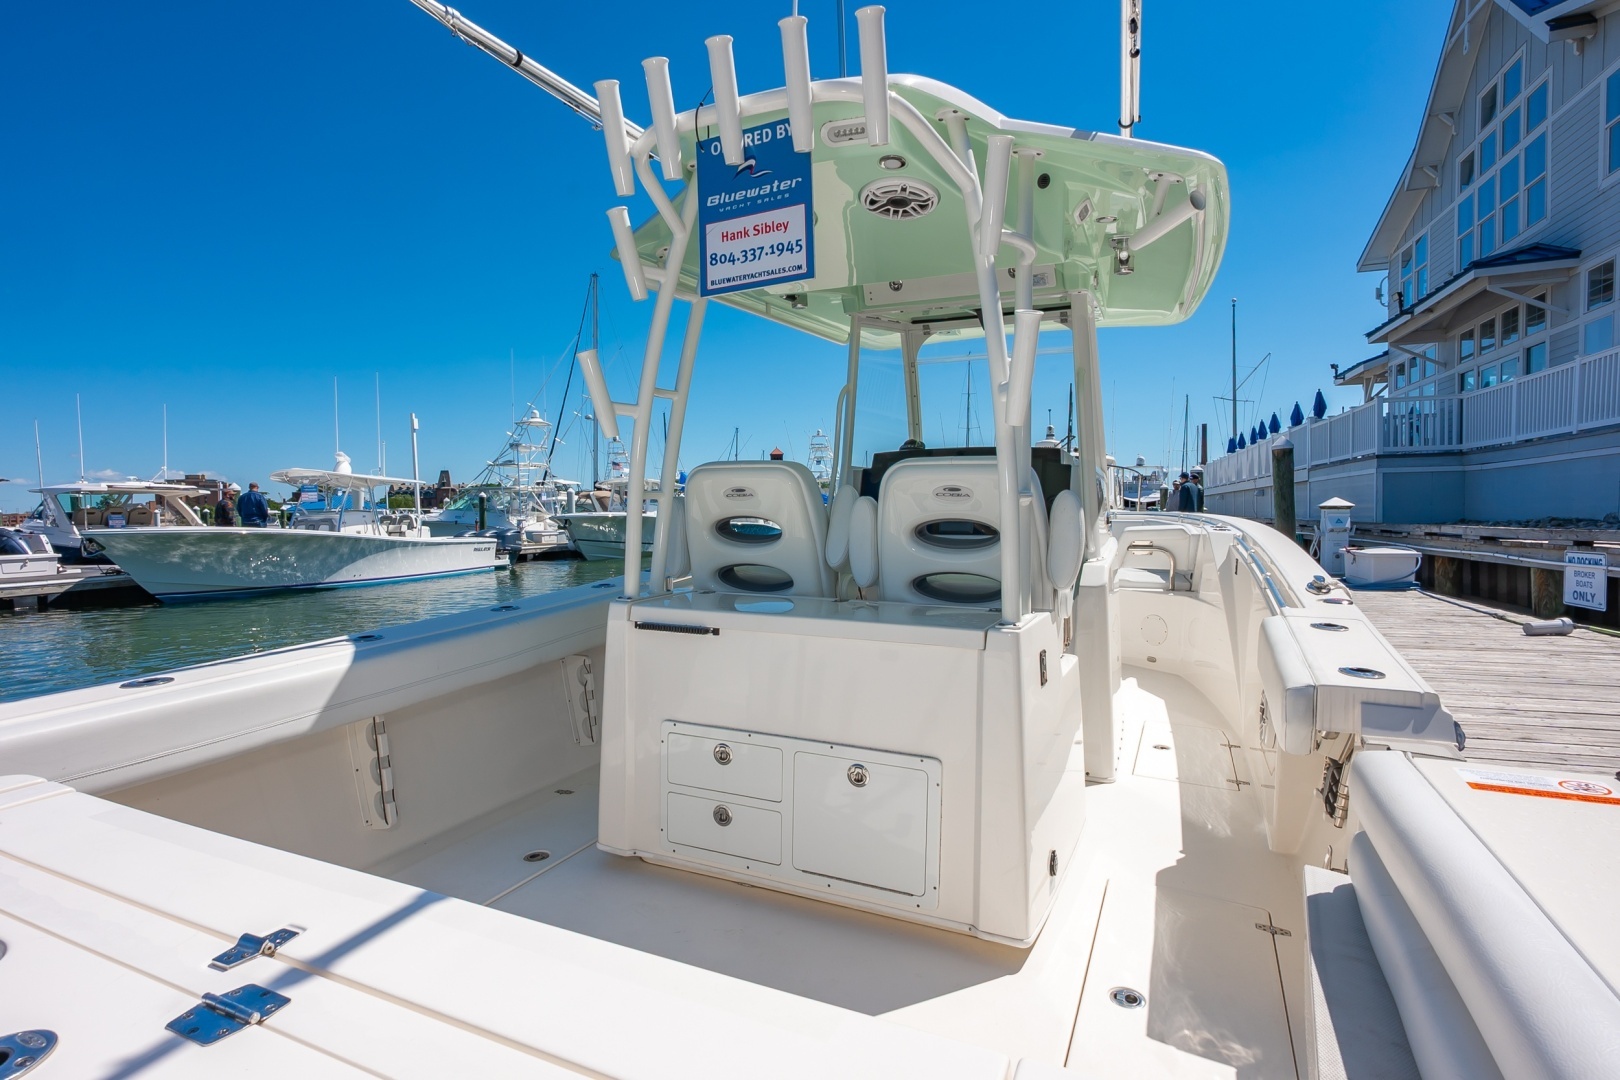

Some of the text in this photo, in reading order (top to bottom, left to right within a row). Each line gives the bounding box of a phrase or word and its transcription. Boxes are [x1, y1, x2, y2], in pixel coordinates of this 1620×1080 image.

[711, 123, 792, 156] ORED BY
[706, 177, 803, 207] Bluewater
[719, 193, 790, 213] YACHT SALES
[721, 220, 790, 243] Hank Sibley
[709, 238, 803, 267] 804.337.1945
[710, 264, 803, 287] BLUEWATERYACHTSALES.COM
[1574, 570, 1595, 579] BROKER
[1576, 580, 1593, 589] BOATS
[1573, 591, 1596, 603] ONLY
